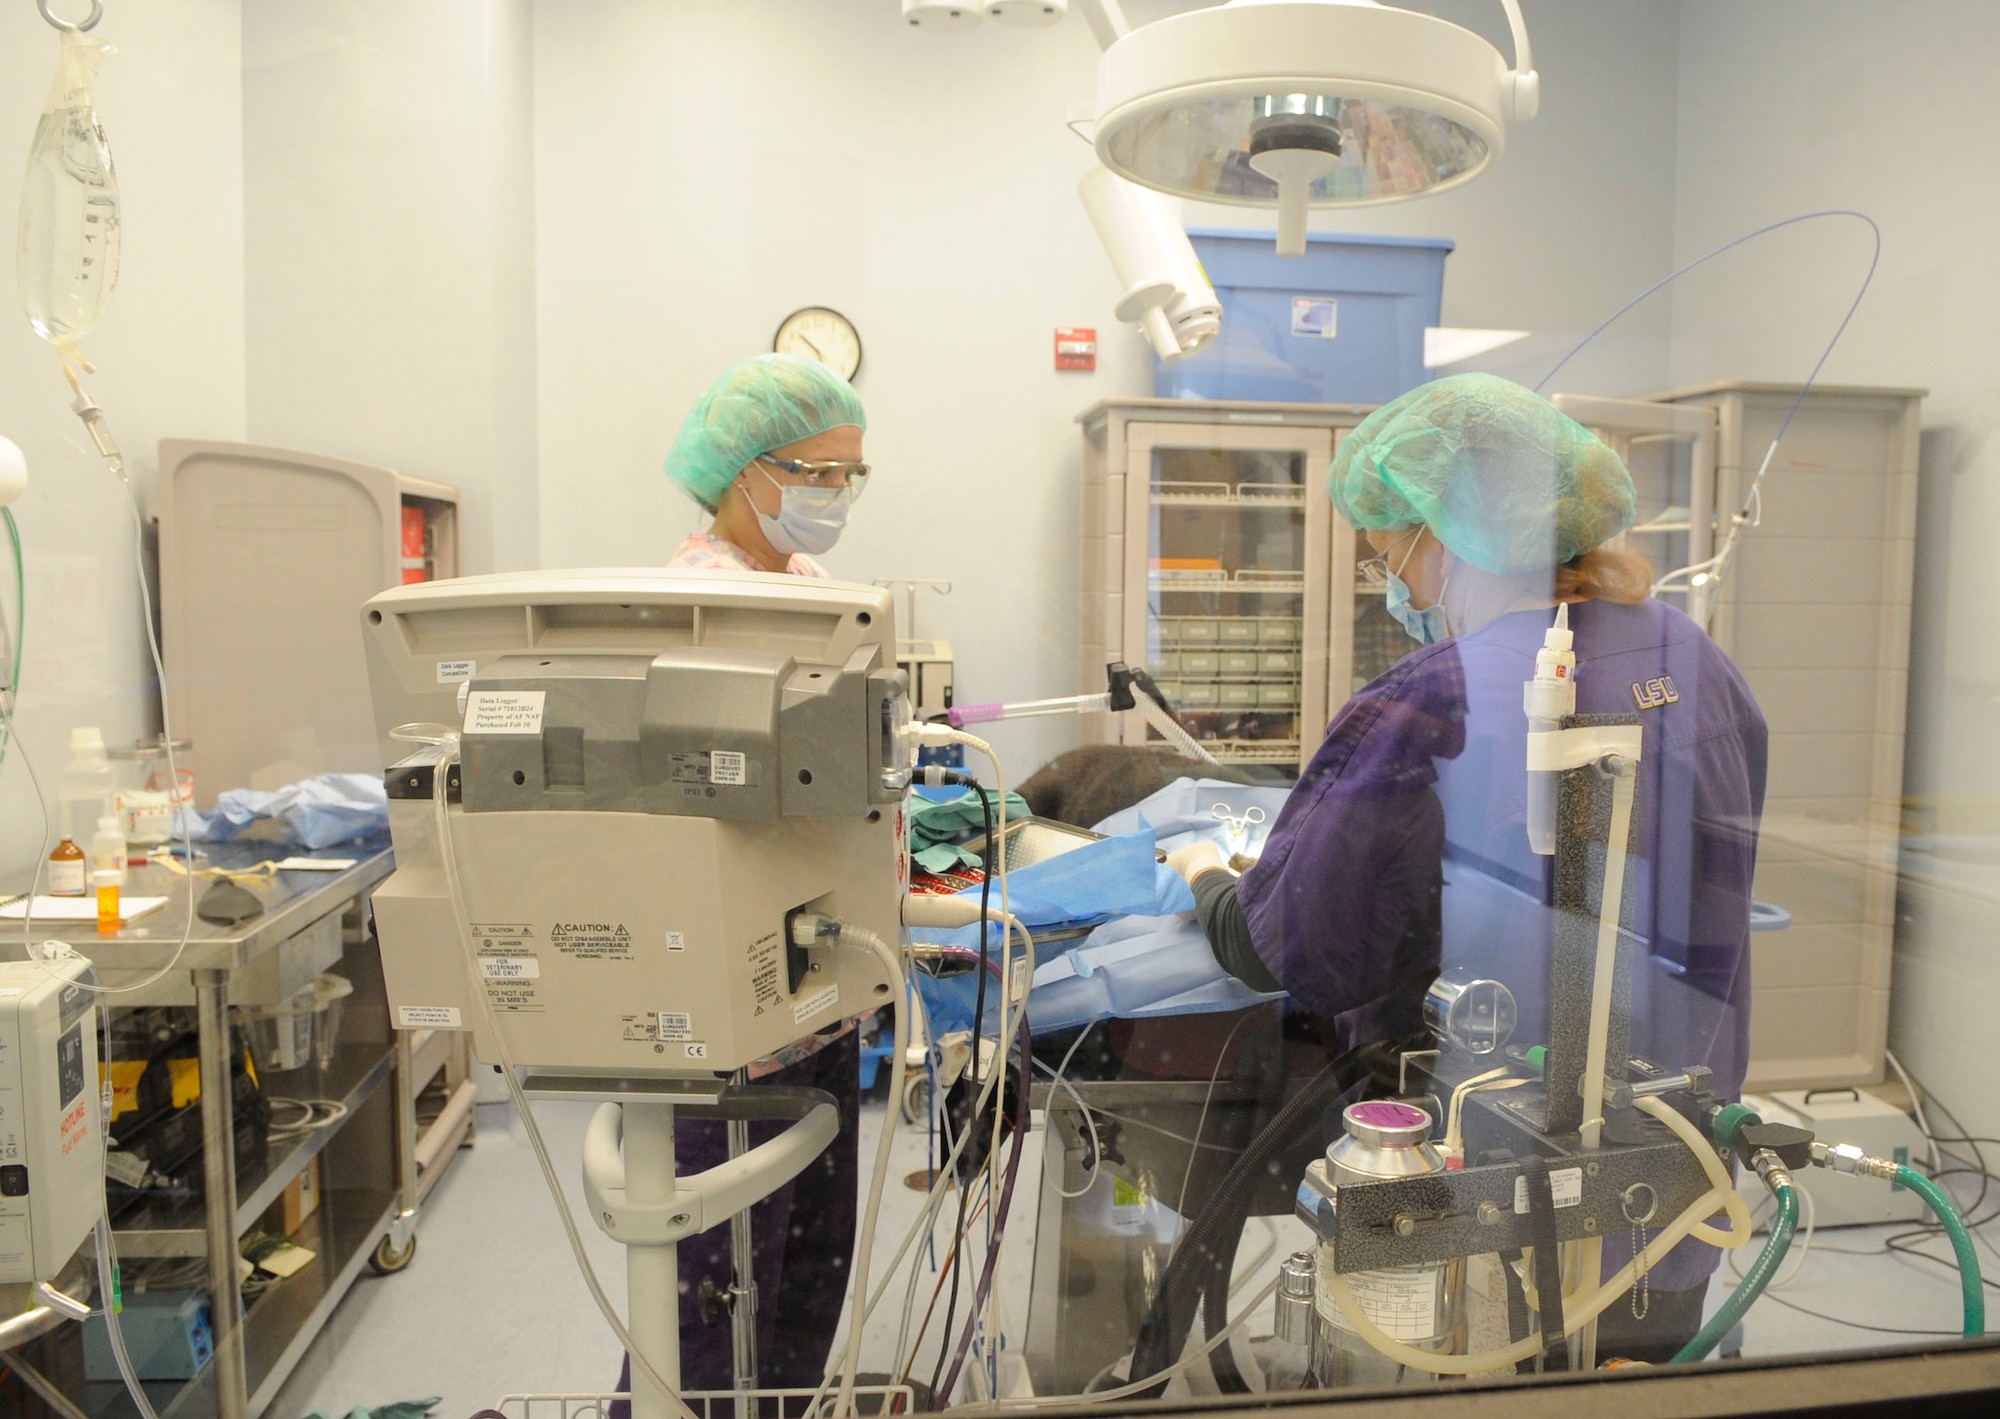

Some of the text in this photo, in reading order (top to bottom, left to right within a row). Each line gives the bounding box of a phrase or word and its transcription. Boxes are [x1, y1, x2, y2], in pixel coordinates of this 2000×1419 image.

[1631, 675, 1679, 710] LSU
[564, 923, 614, 932] CAUTION:
[687, 1046, 703, 1057] CE
[61, 1102, 85, 1137] HOTLINE
